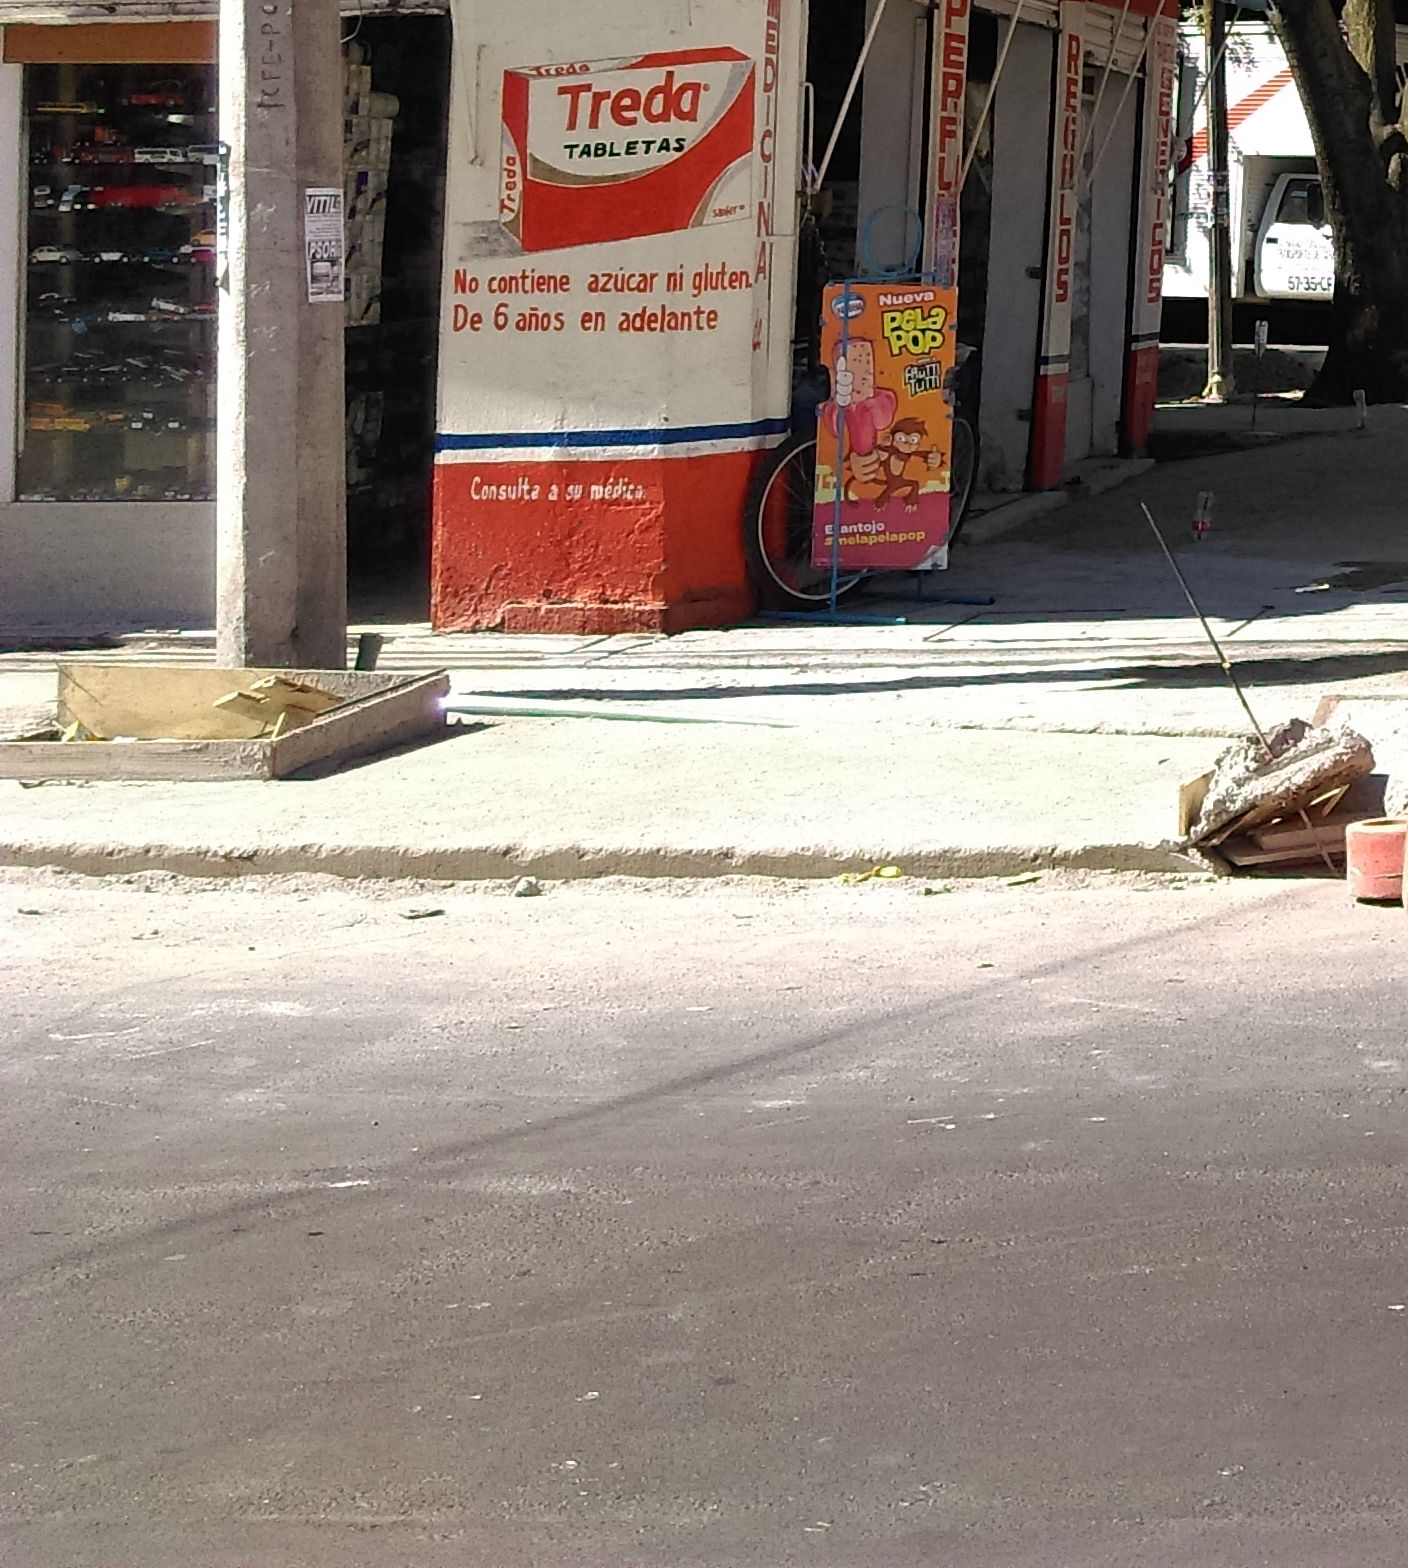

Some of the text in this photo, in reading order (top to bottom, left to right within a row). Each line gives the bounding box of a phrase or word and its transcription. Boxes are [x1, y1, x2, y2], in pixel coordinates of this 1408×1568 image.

[529, 62, 592, 78] Treda
[557, 70, 703, 132] Treda
[563, 136, 688, 161] TABLETAS
[500, 154, 518, 217] Treda
[453, 261, 753, 299] No contiene azúcar ni gluten.
[878, 290, 935, 307] Nueva
[452, 303, 484, 333] De
[492, 301, 511, 332] 6
[514, 306, 566, 332] años
[579, 311, 607, 333] en
[617, 302, 719, 334] adelante
[889, 329, 944, 356] POP
[470, 475, 541, 501] Consulta
[547, 483, 560, 502] a
[565, 483, 584, 502] su
[840, 520, 885, 535] antojo
